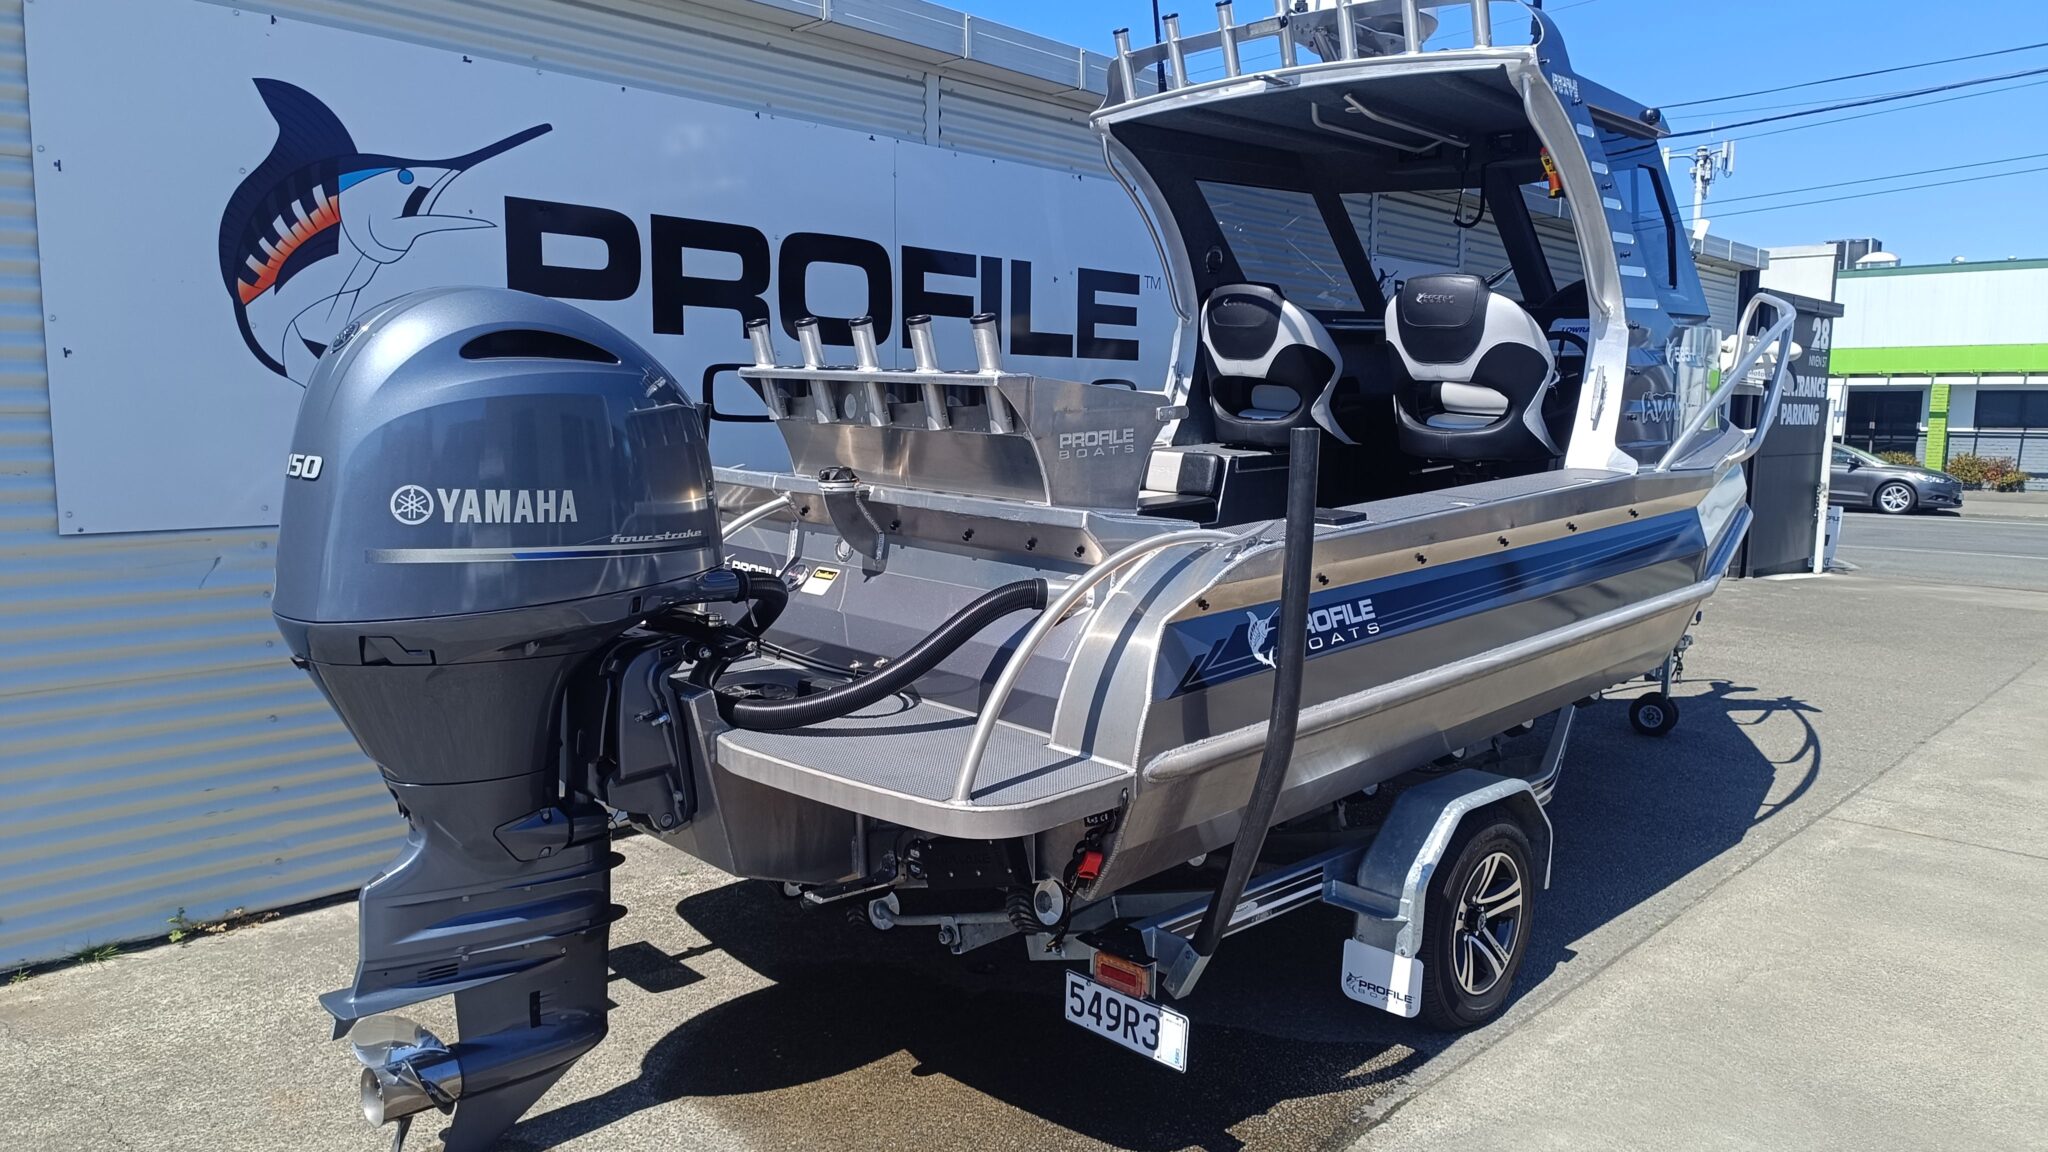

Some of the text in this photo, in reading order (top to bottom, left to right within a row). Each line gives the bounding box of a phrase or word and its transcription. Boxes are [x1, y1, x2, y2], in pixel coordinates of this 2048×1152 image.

[504, 195, 1140, 361] PROFILE
[1810, 317, 1831, 352] 28
[1782, 375, 1826, 398] TRANCE
[1780, 403, 1820, 425] PARKING
[1059, 428, 1135, 448] PROFILE
[1059, 445, 1135, 460] BOATS
[437, 488, 578, 523] YAMAHA
[1307, 598, 1376, 635] ROFILE
[1308, 622, 1381, 650] OATS
[1357, 988, 1413, 1010] BOAS
[1358, 980, 1414, 1005] PROFILE
[1070, 981, 1161, 1051] 549R3
